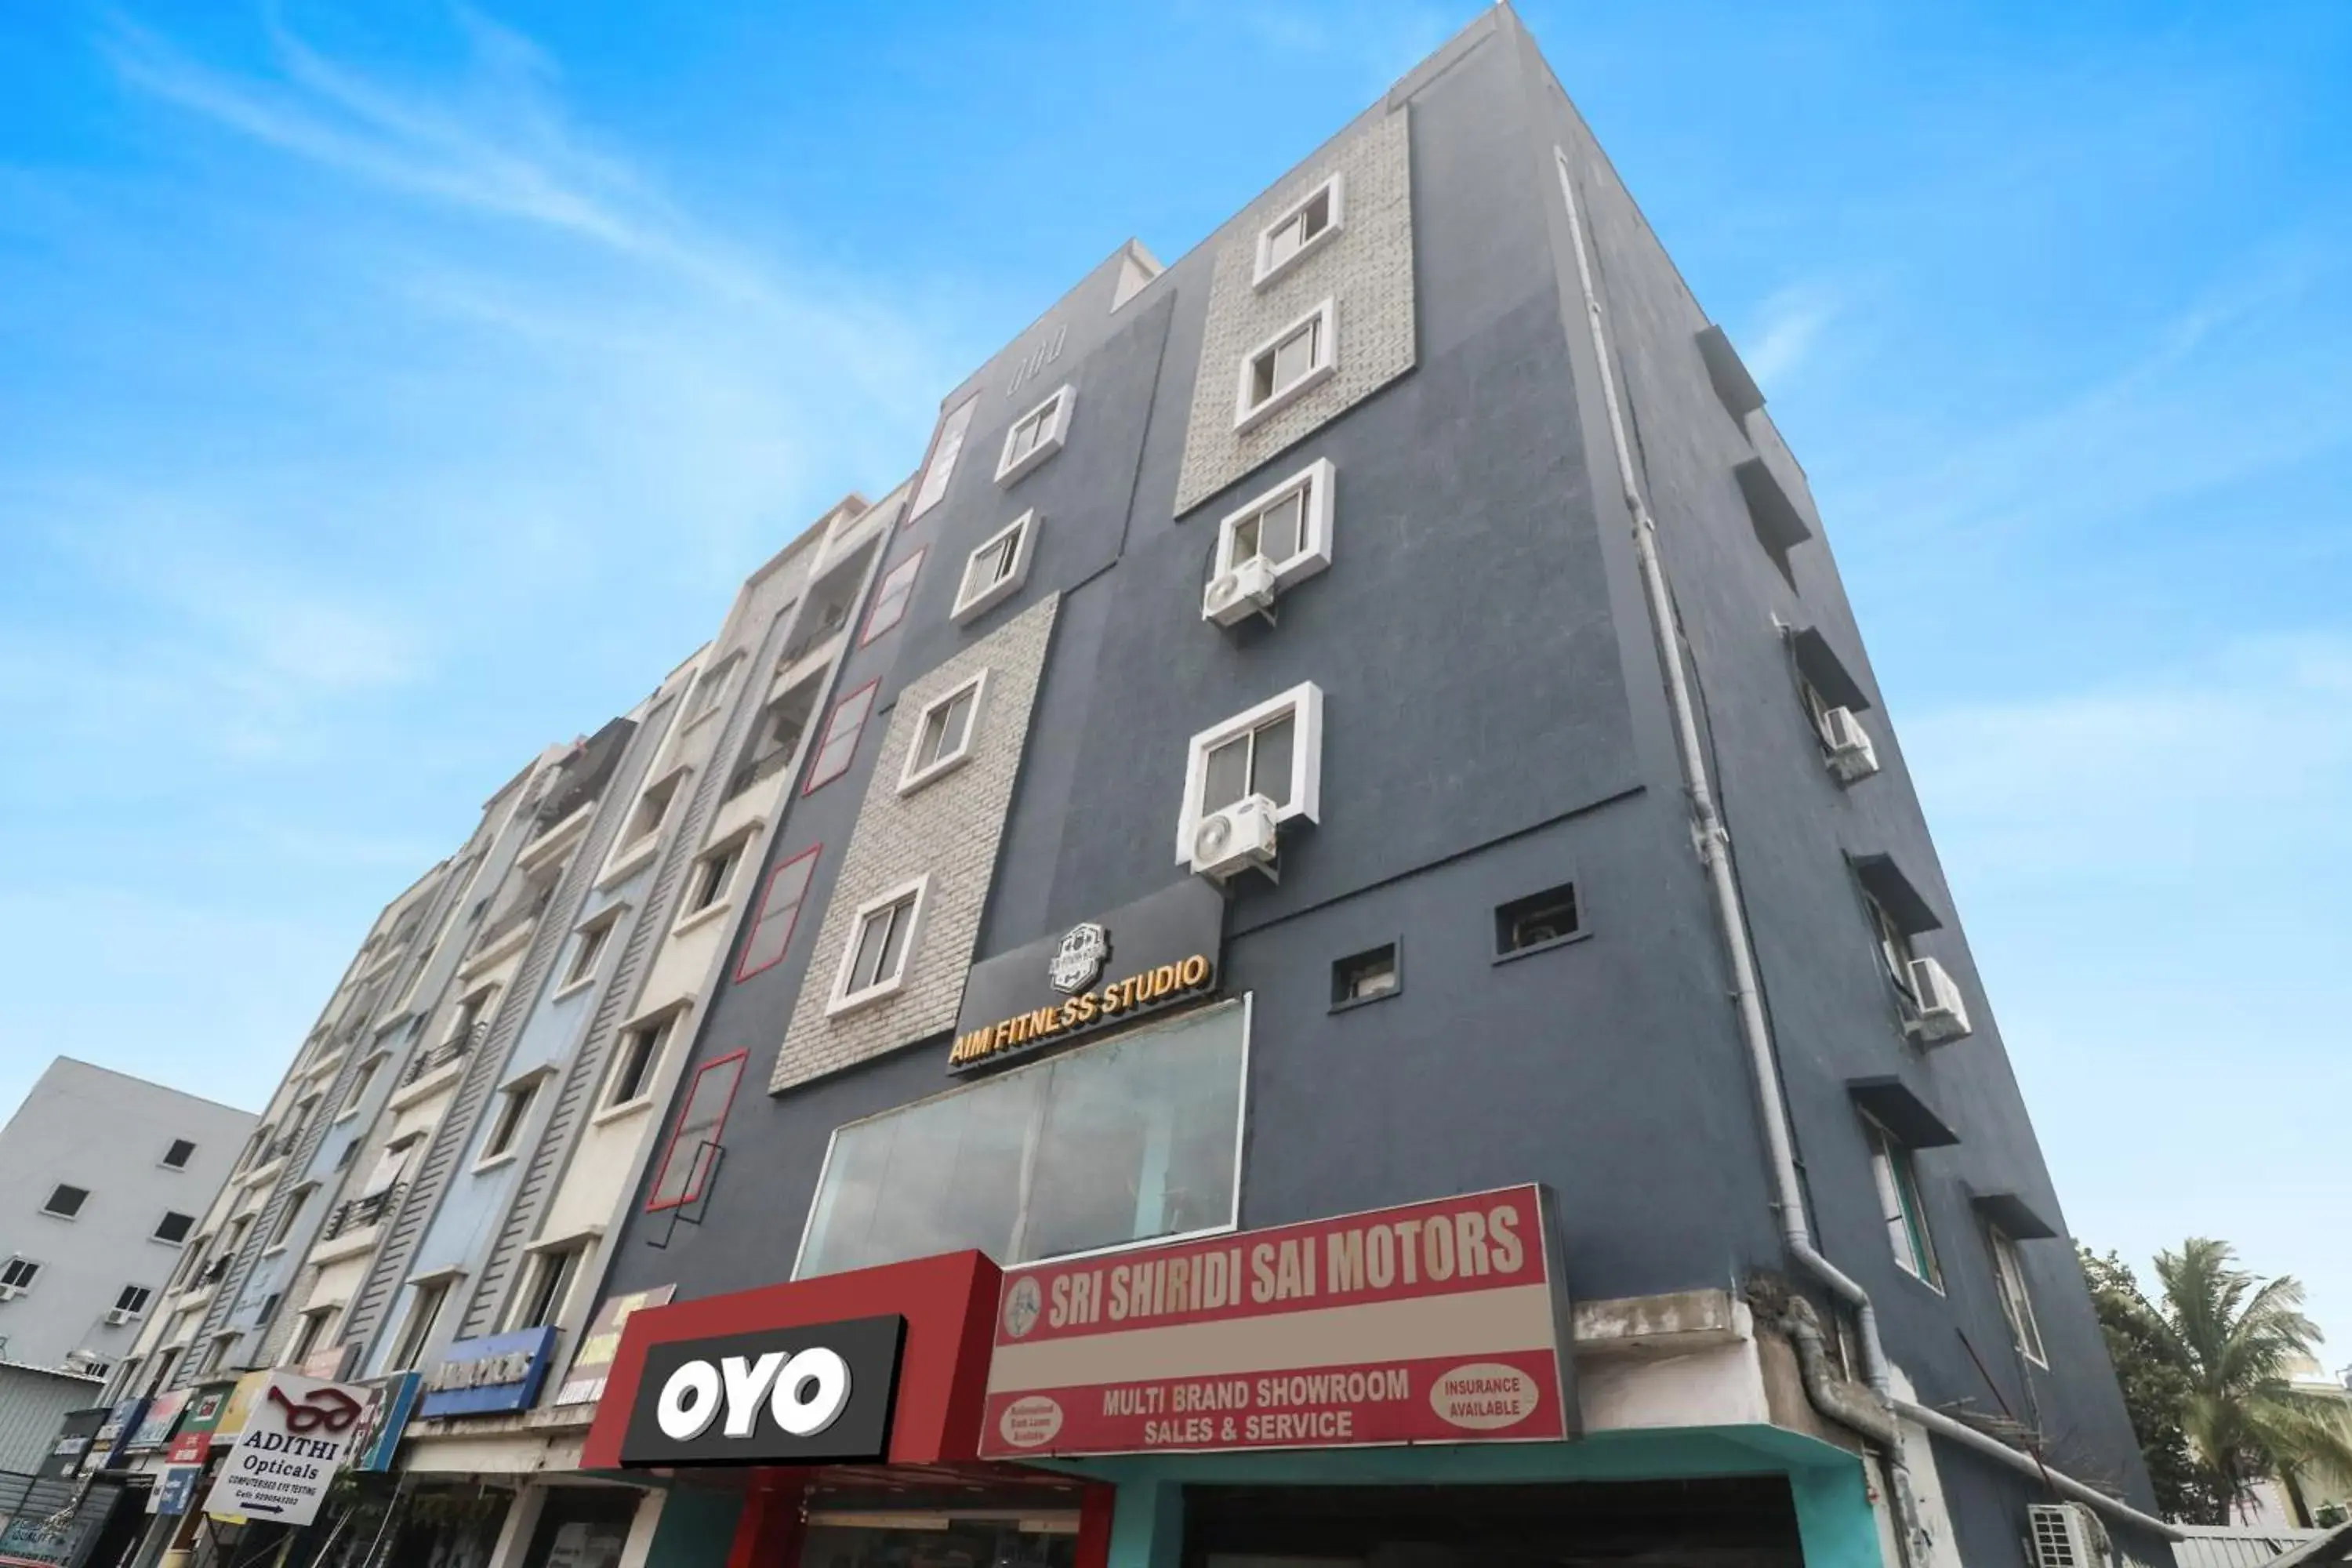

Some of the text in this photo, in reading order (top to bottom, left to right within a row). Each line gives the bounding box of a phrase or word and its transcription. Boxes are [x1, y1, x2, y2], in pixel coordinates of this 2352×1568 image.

[949, 1026, 993, 1066] AIM
[993, 991, 1099, 1051] FITNESS
[1101, 953, 1212, 1014] STUDIO
[1048, 1204, 1525, 1329] SRI SHIRIDI SAI MOTORS
[657, 1346, 852, 1442] OYO
[1103, 1368, 1410, 1416] MULTI BRAND SHOWROOM
[1444, 1376, 1521, 1396] INSURANCE
[1449, 1399, 1521, 1418] AVAILABLE
[1144, 1411, 1352, 1444] SALES & SERVICE
[243, 1429, 339, 1461] ADITHI
[243, 1454, 319, 1479] Opticals
